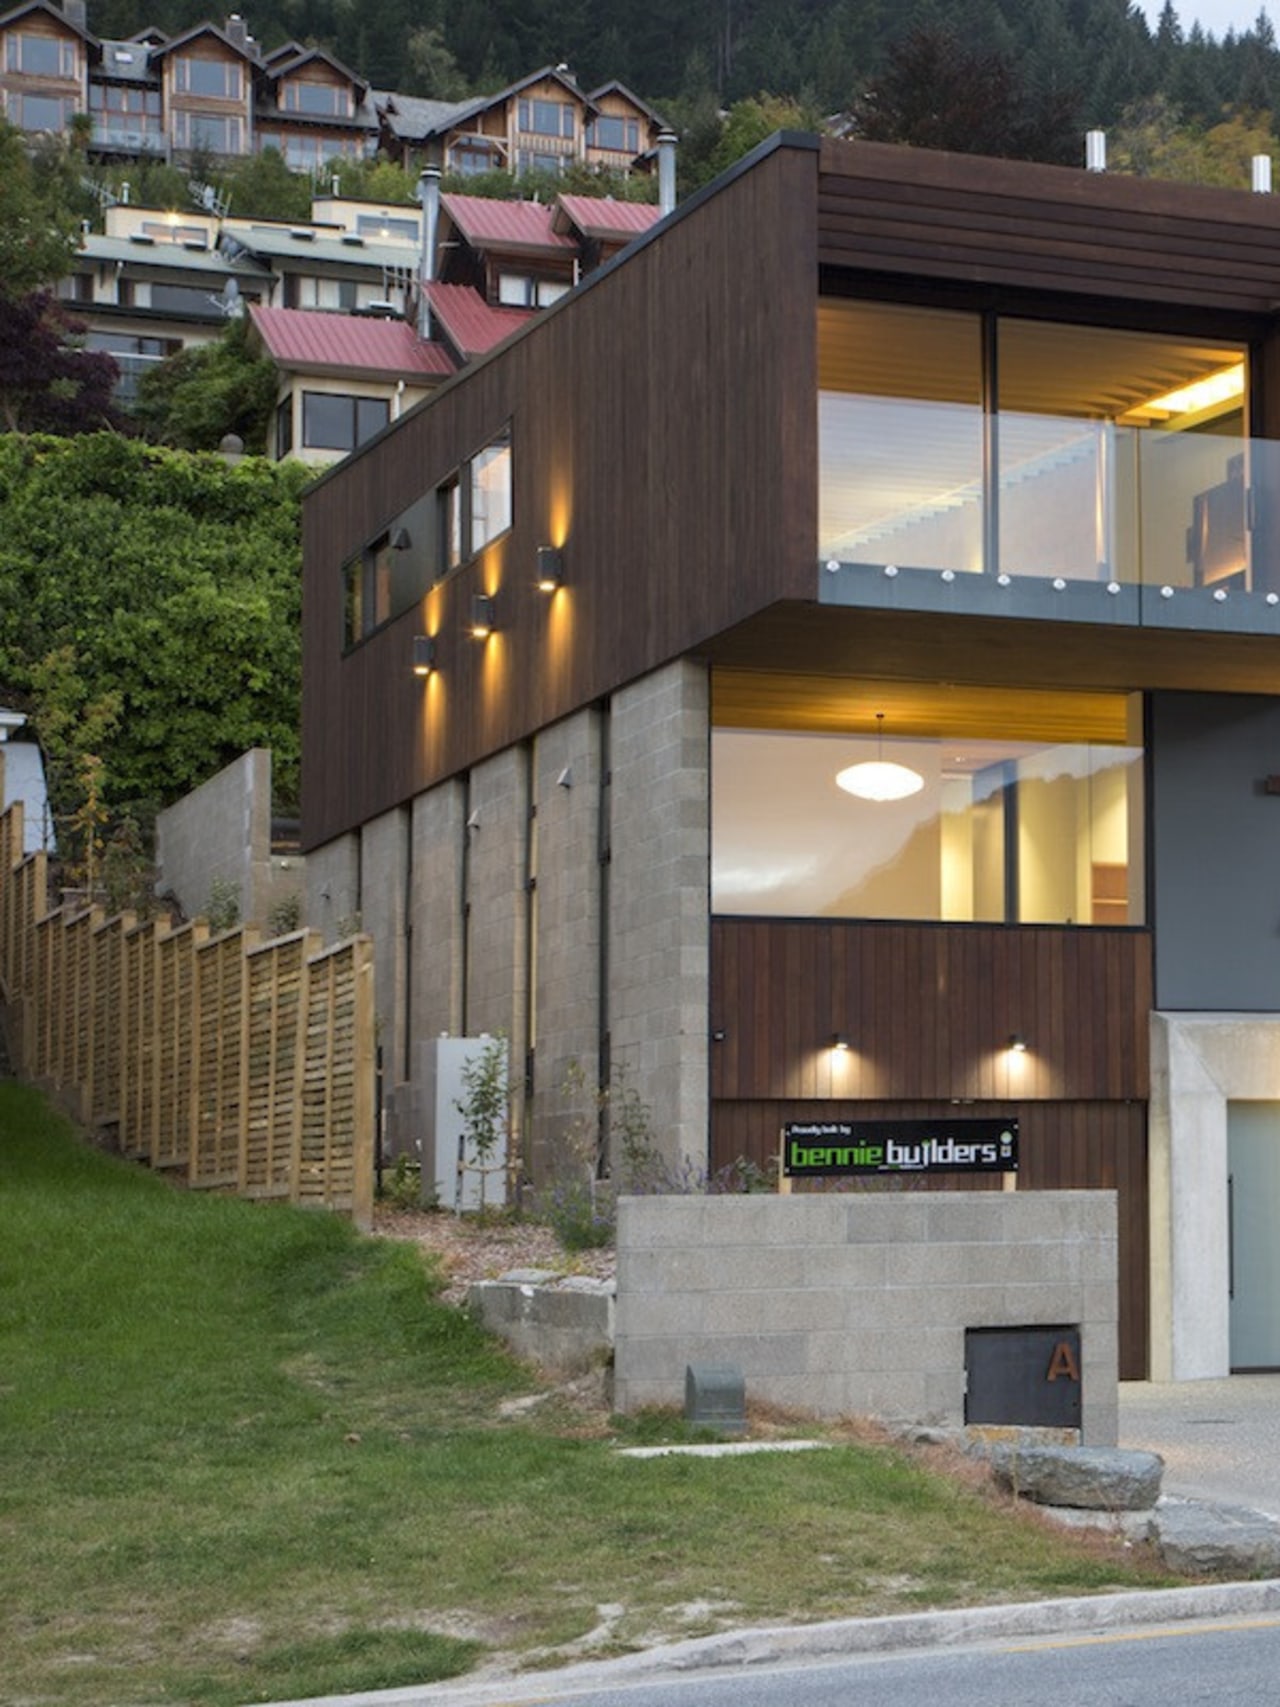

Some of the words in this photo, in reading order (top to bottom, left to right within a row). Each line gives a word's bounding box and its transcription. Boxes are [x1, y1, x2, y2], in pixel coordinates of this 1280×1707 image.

[839, 1124, 852, 1136] by
[791, 1140, 883, 1167] bennie
[887, 1138, 997, 1166] builders
[1047, 1341, 1080, 1382] A
